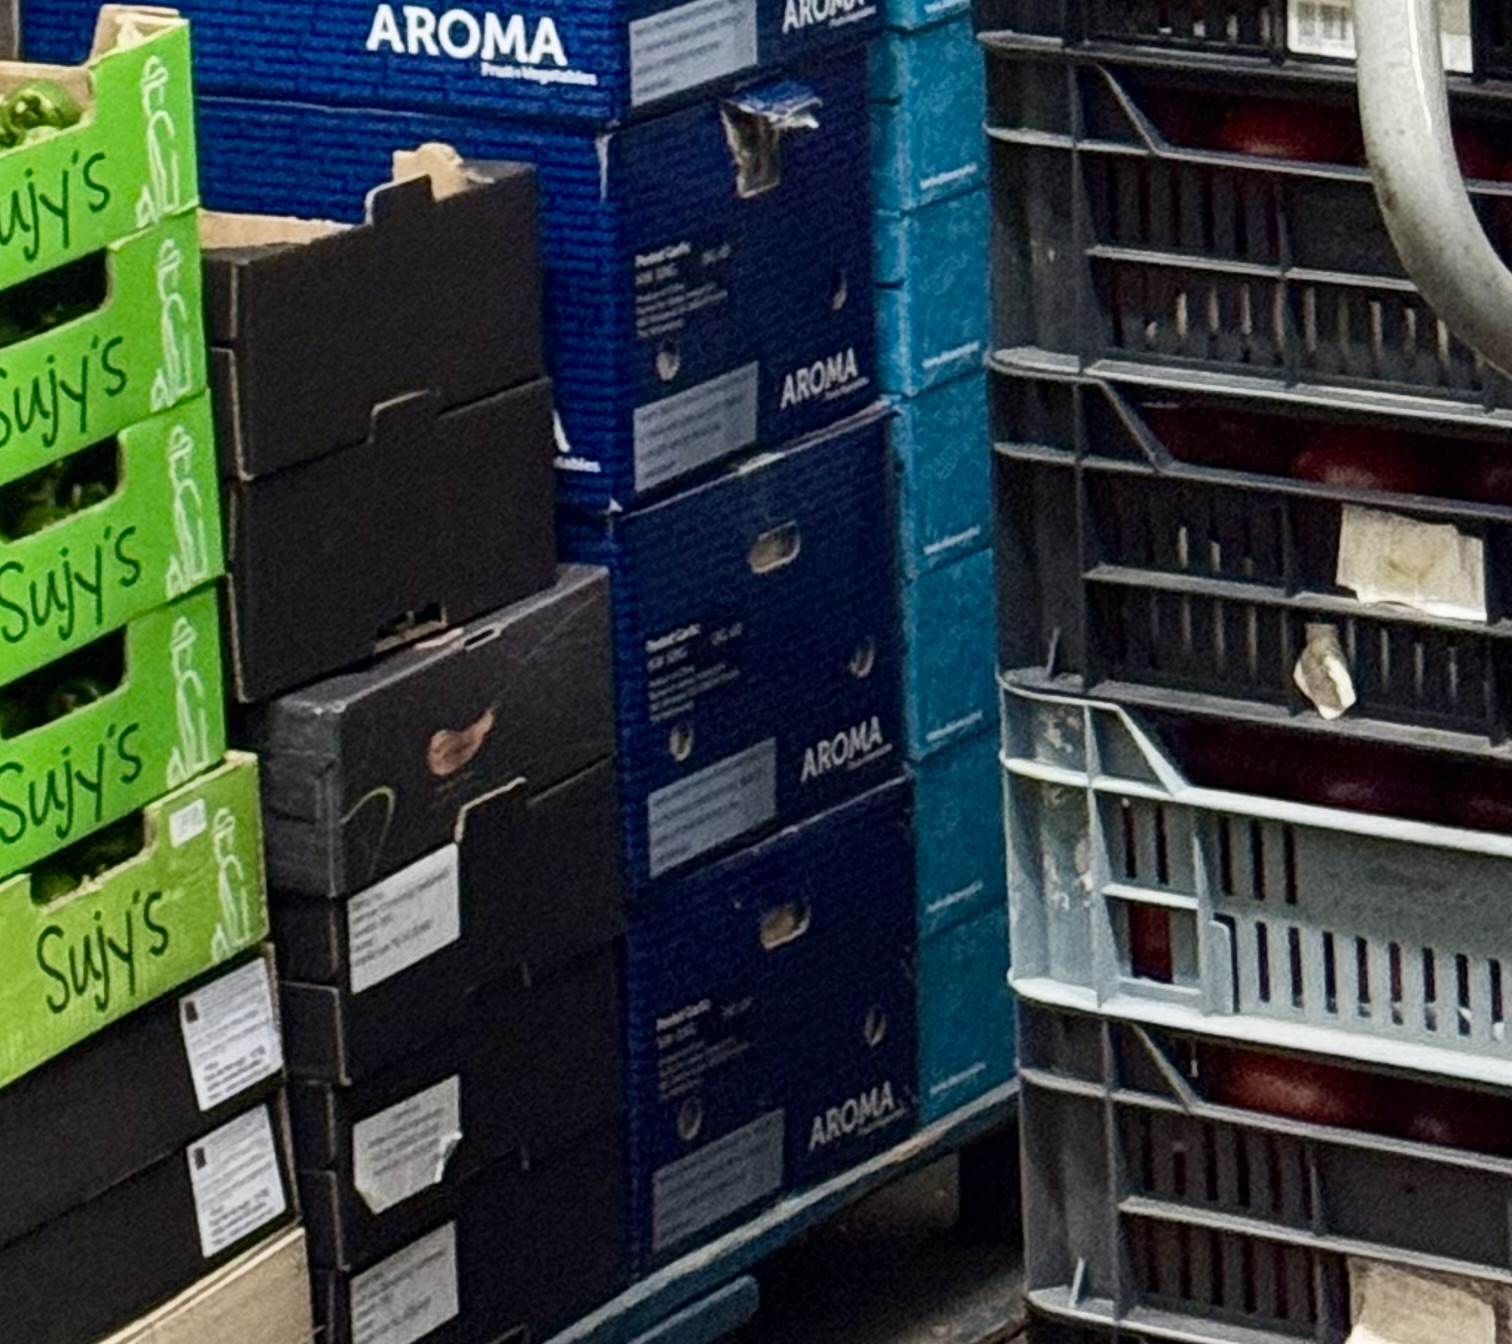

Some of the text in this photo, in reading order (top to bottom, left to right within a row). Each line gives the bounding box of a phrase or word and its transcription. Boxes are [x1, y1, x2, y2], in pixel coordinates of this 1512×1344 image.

[365, 2, 569, 67] AROMA
[779, 346, 859, 410] AROMA
[800, 715, 884, 783] AROMA
[34, 888, 171, 1017] Sujy's
[808, 1080, 895, 1152] AROMA
